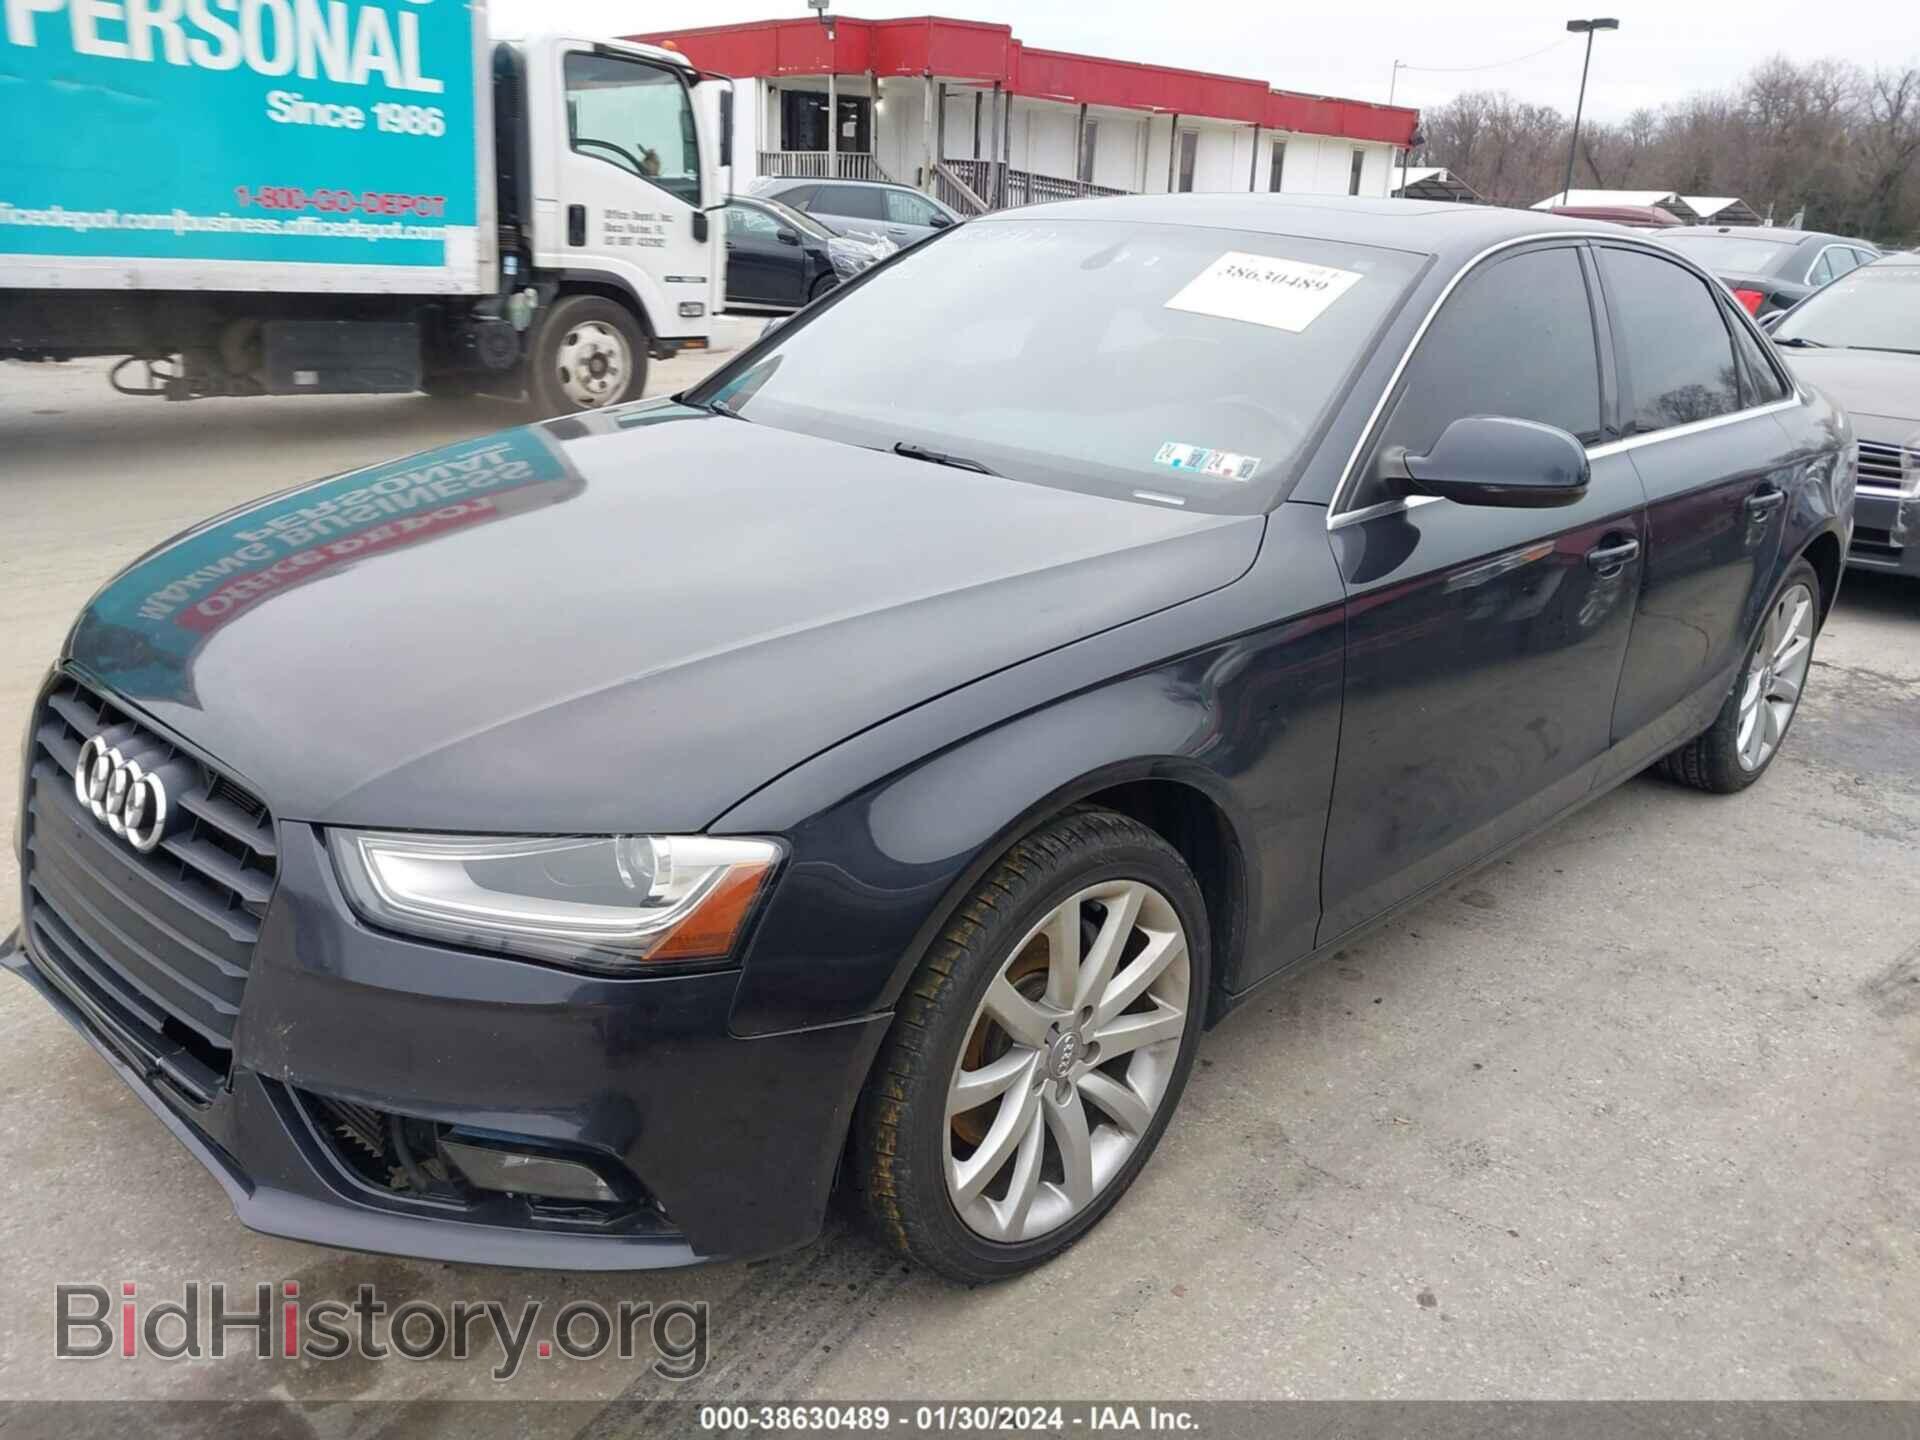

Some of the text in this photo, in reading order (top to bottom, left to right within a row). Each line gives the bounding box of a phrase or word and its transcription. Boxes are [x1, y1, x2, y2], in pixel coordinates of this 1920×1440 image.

[5, 0, 445, 93] PERSONAL
[266, 89, 446, 138] Since 1986
[1217, 264, 1329, 292] 38630489
